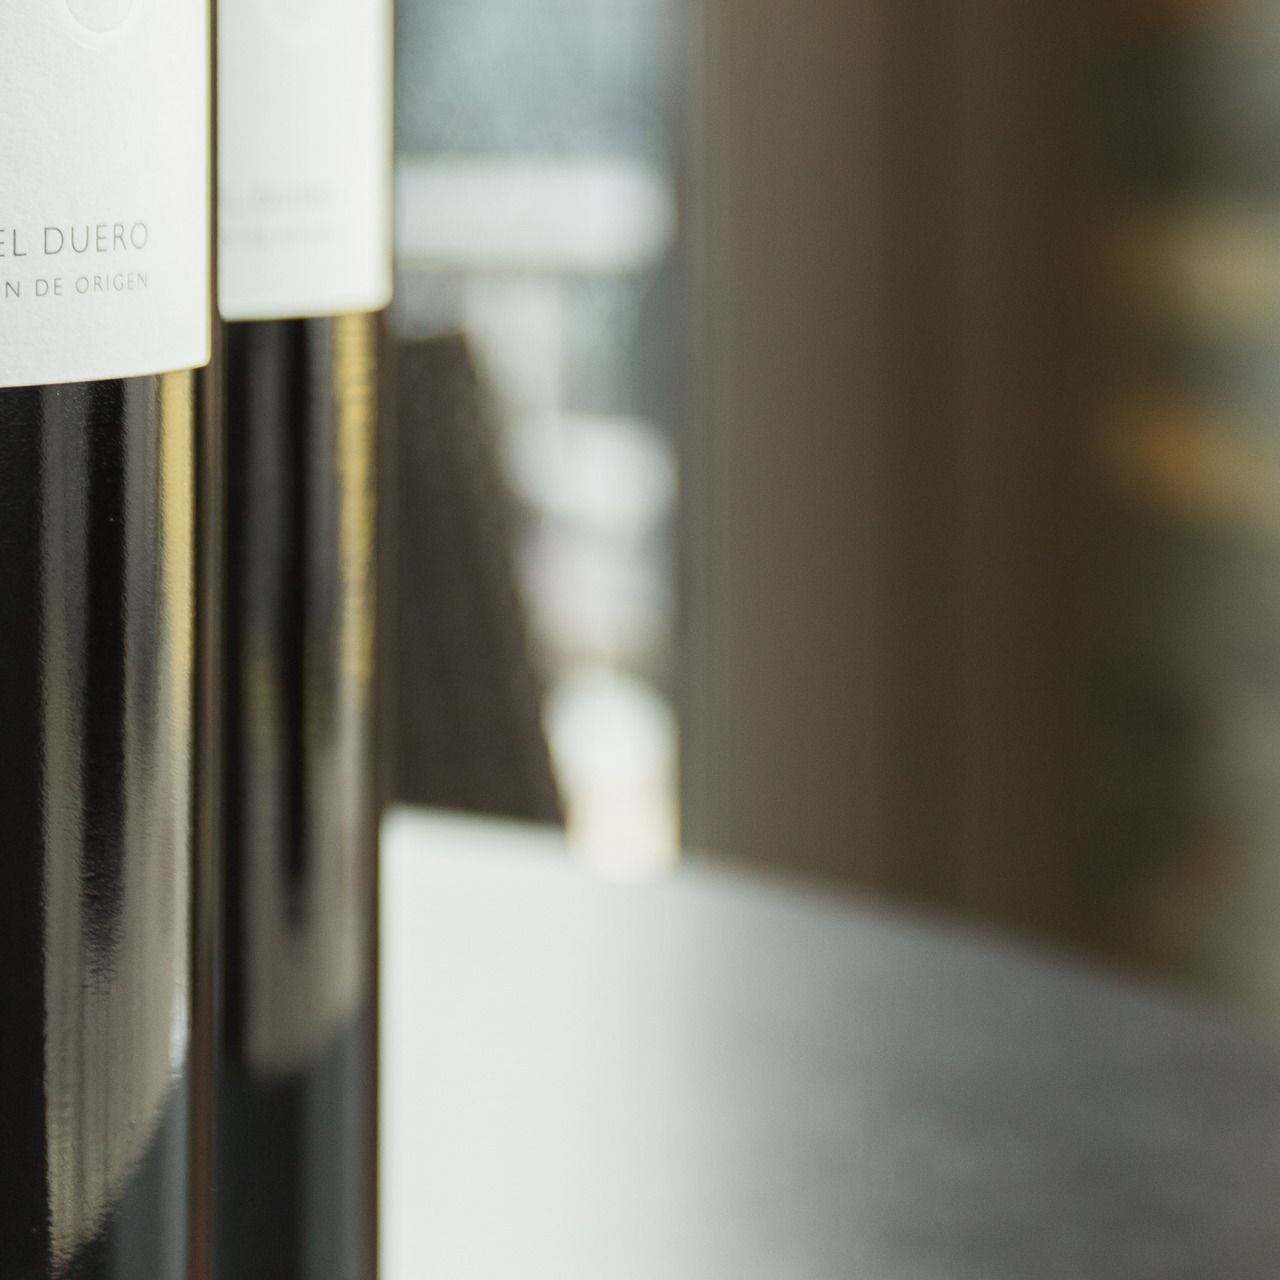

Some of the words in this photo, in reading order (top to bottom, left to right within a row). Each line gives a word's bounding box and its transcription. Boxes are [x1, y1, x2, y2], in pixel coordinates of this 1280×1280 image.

[43, 221, 149, 255] DUERO
[35, 277, 64, 297] DE
[75, 270, 149, 295] ORIGEN
